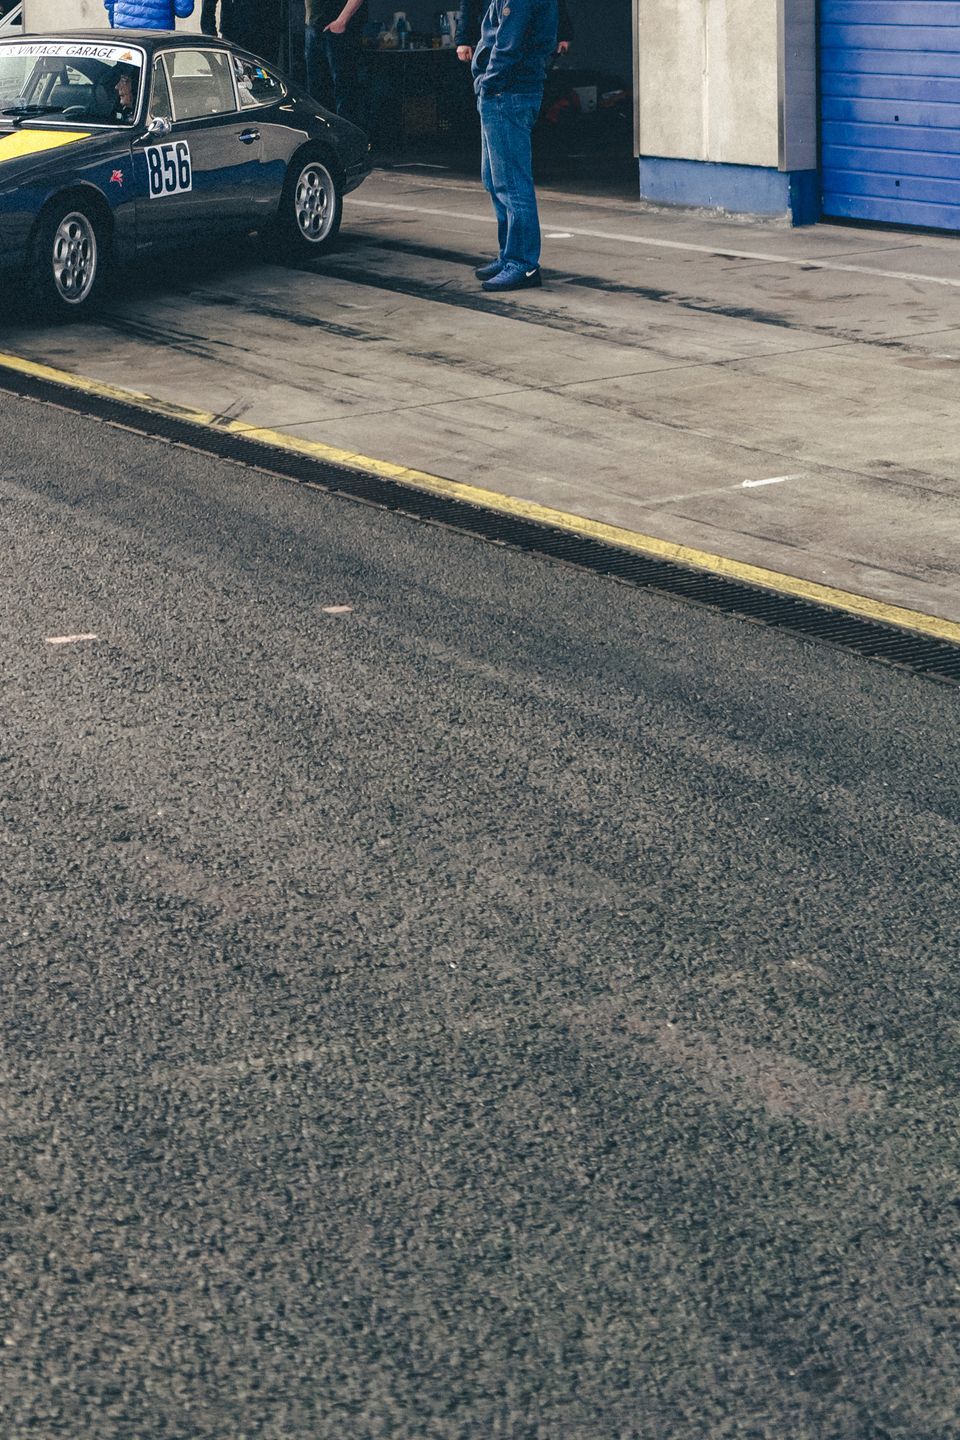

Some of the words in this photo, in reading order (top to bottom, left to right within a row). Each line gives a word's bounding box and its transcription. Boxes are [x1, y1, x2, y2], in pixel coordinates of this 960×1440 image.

[17, 45, 63, 56] VINTAGE
[65, 46, 117, 59] GARAGE
[147, 142, 191, 195] 856
